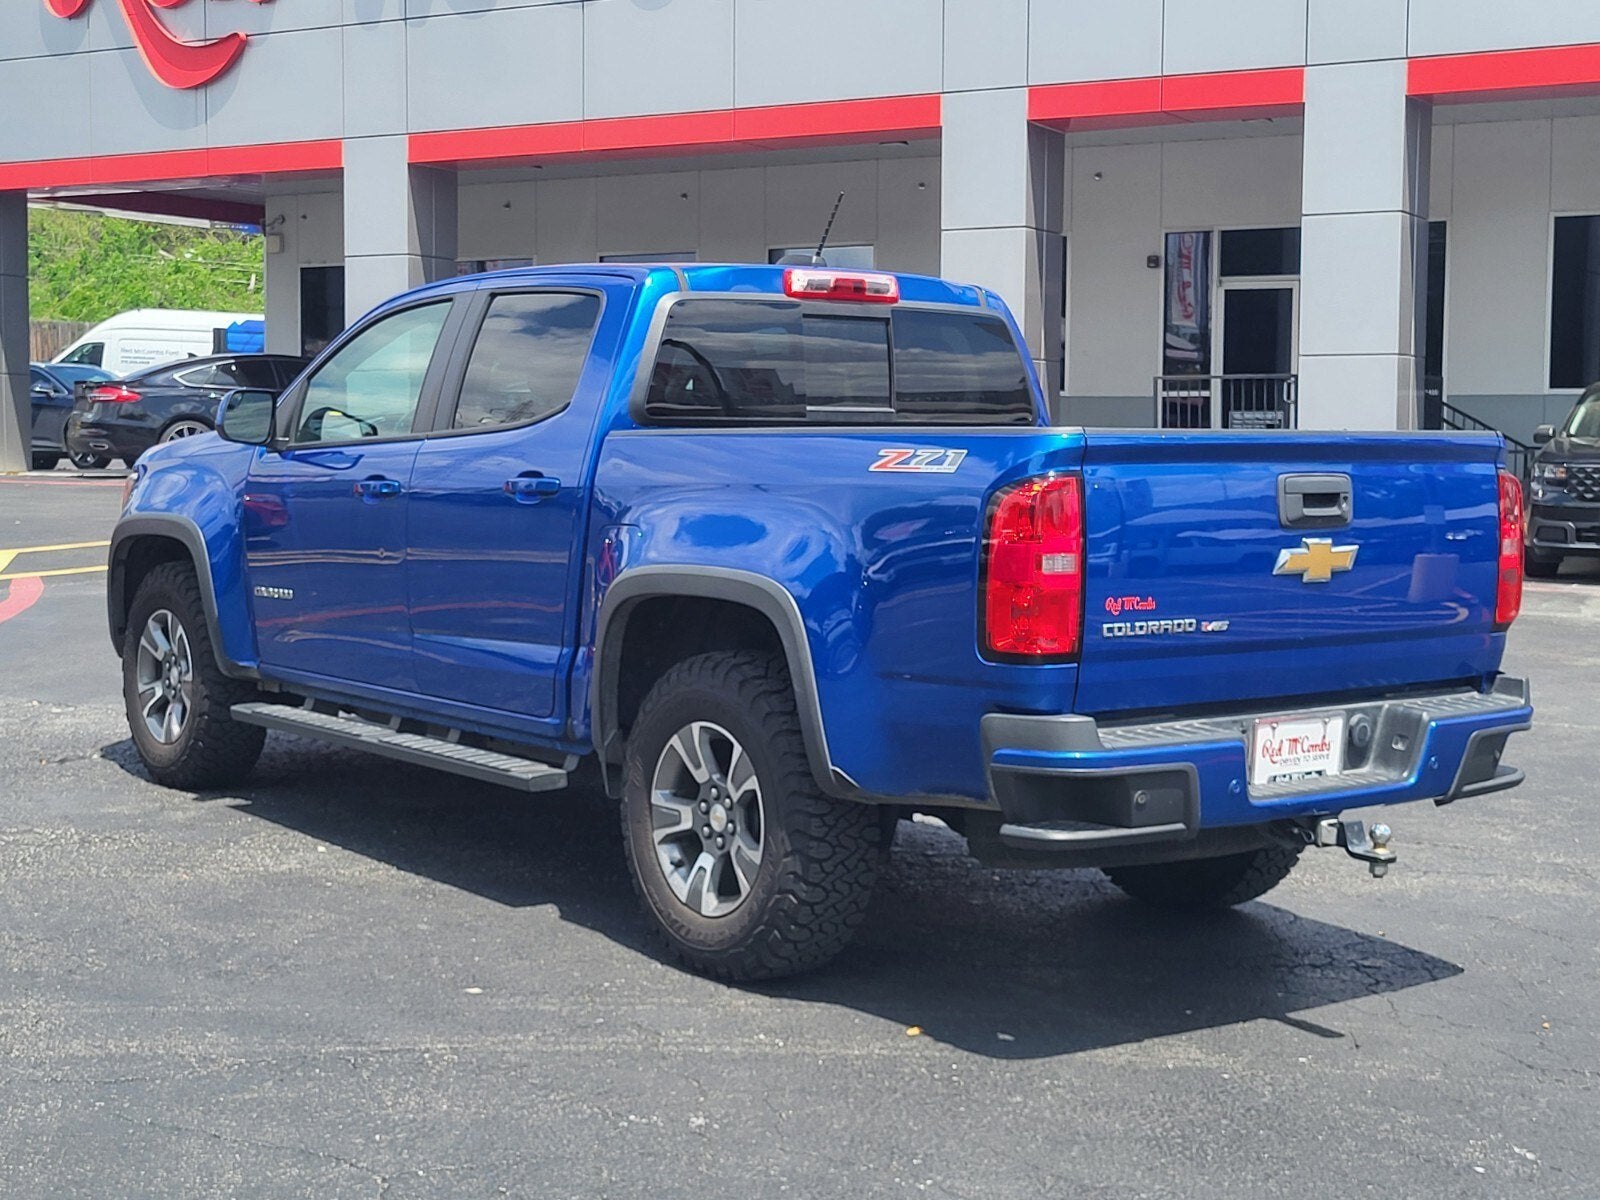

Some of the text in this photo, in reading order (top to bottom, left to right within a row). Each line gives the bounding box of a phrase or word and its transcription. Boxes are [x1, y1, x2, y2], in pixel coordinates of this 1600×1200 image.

[868, 449, 968, 473] Z71
[1105, 596, 1121, 615] Red
[1102, 618, 1197, 637] COLORADO
[1262, 735, 1332, 764] Red McCombs
